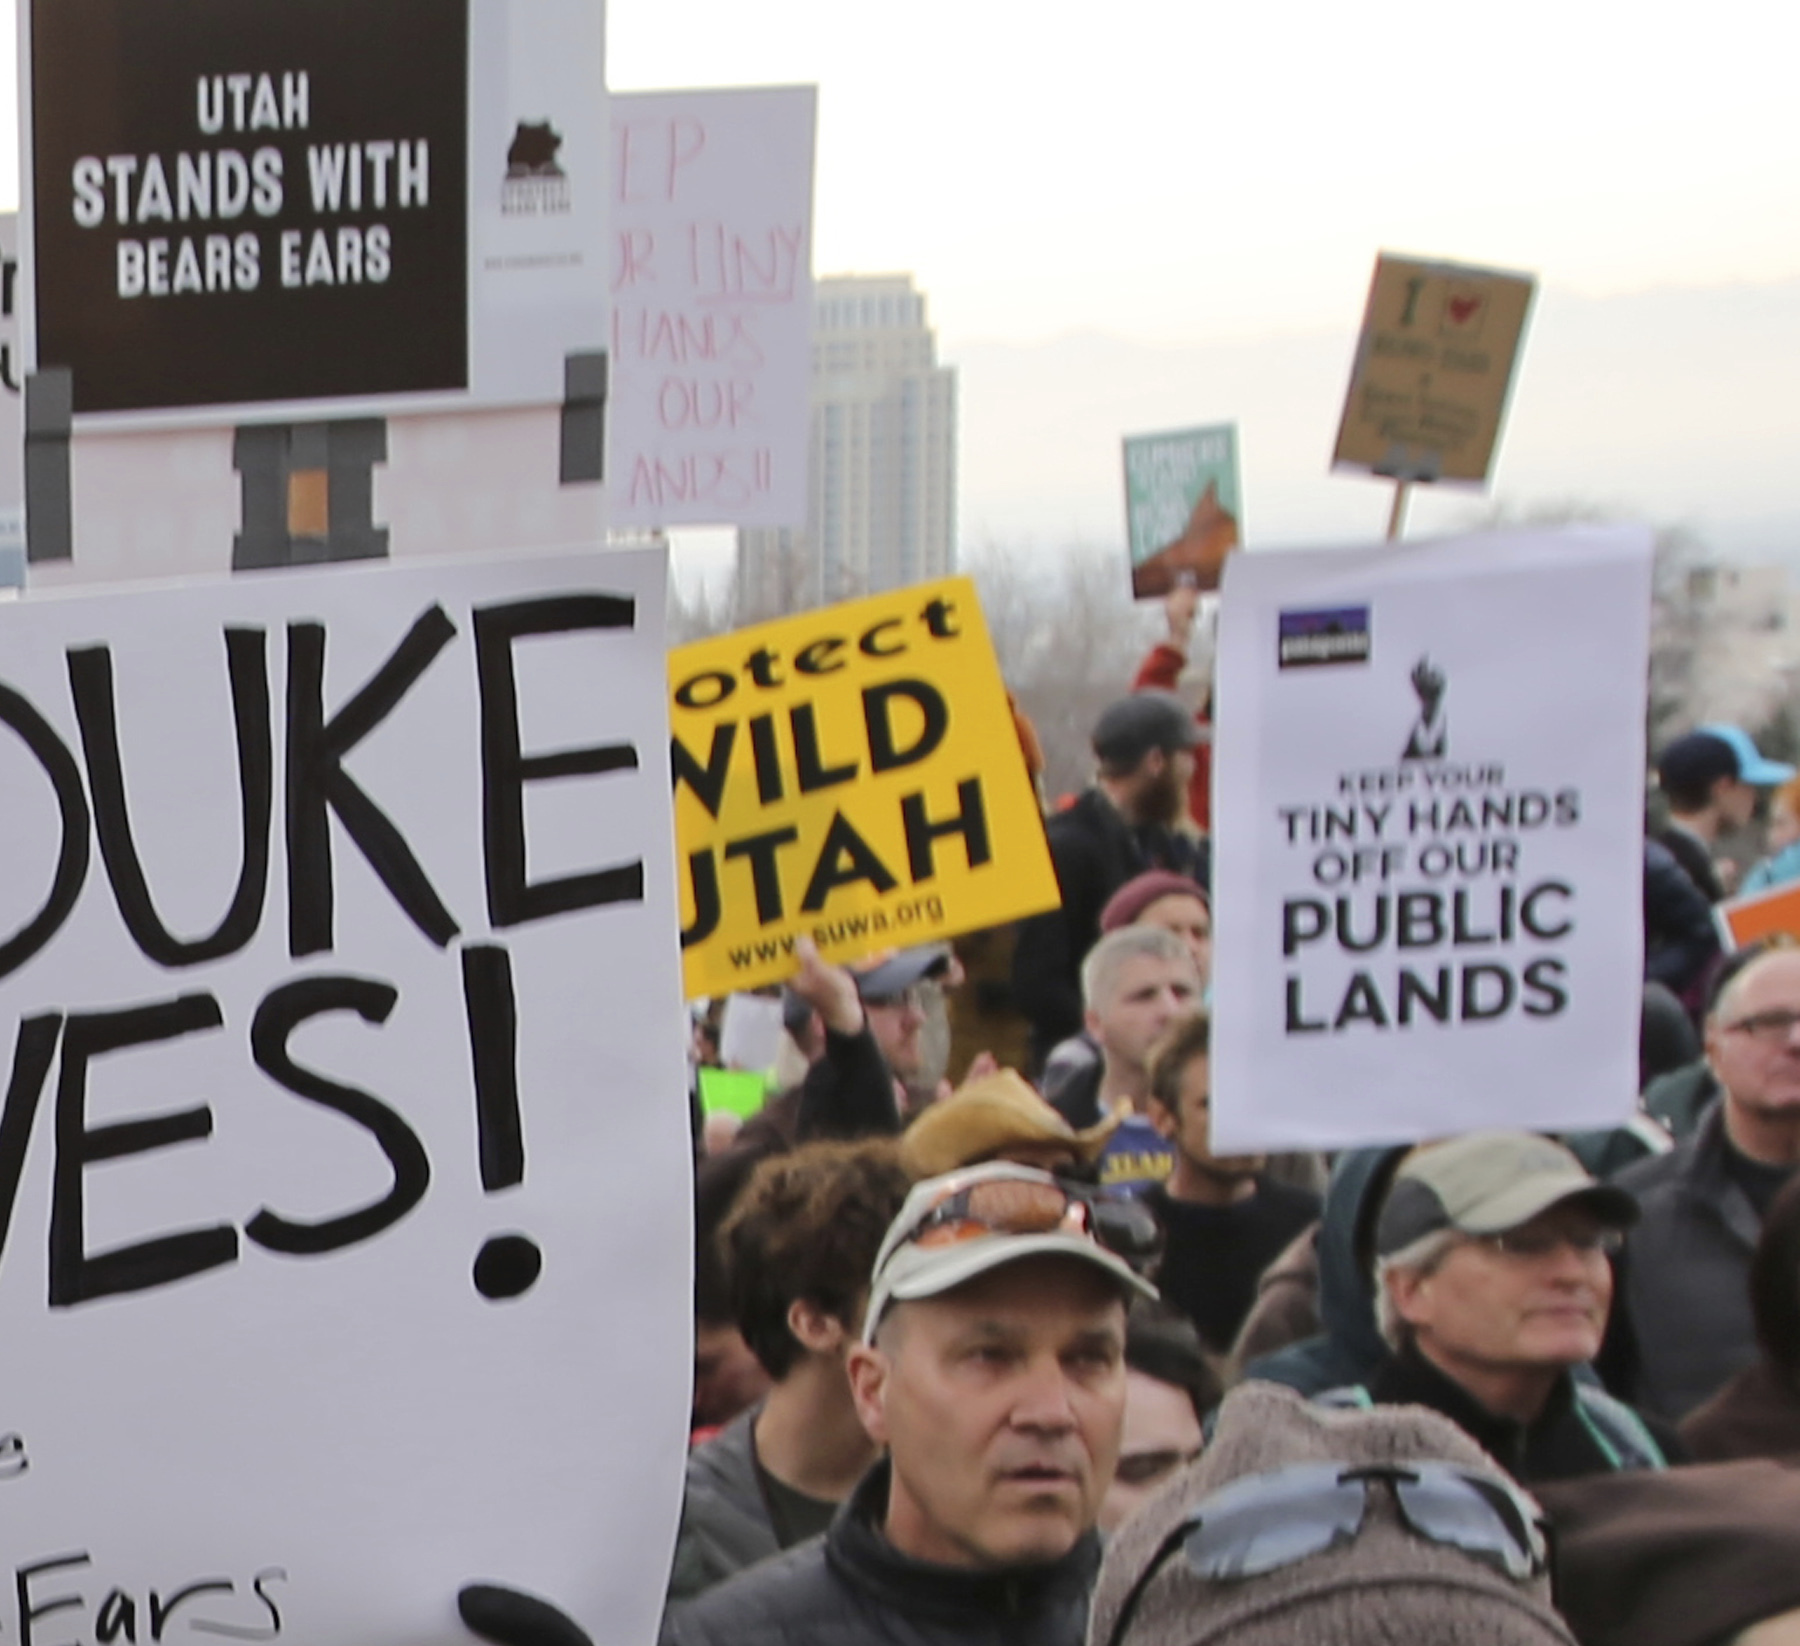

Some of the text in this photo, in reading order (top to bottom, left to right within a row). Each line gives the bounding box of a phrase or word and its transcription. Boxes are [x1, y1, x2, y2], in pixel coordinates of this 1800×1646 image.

[197, 70, 309, 135] UTAH
[72, 137, 429, 228] STANDS WITH
[117, 224, 392, 298] BEARS EARS
[670, 678, 949, 822] WILD
[1338, 762, 1505, 795] KEEP YOUR
[1278, 788, 1581, 843] TINY HANDS
[1313, 838, 1520, 885] OFF OUR
[728, 896, 945, 970] wwwsuwa.org
[1282, 880, 1575, 957] PUBLIC
[1285, 957, 1569, 1036] LANDS
